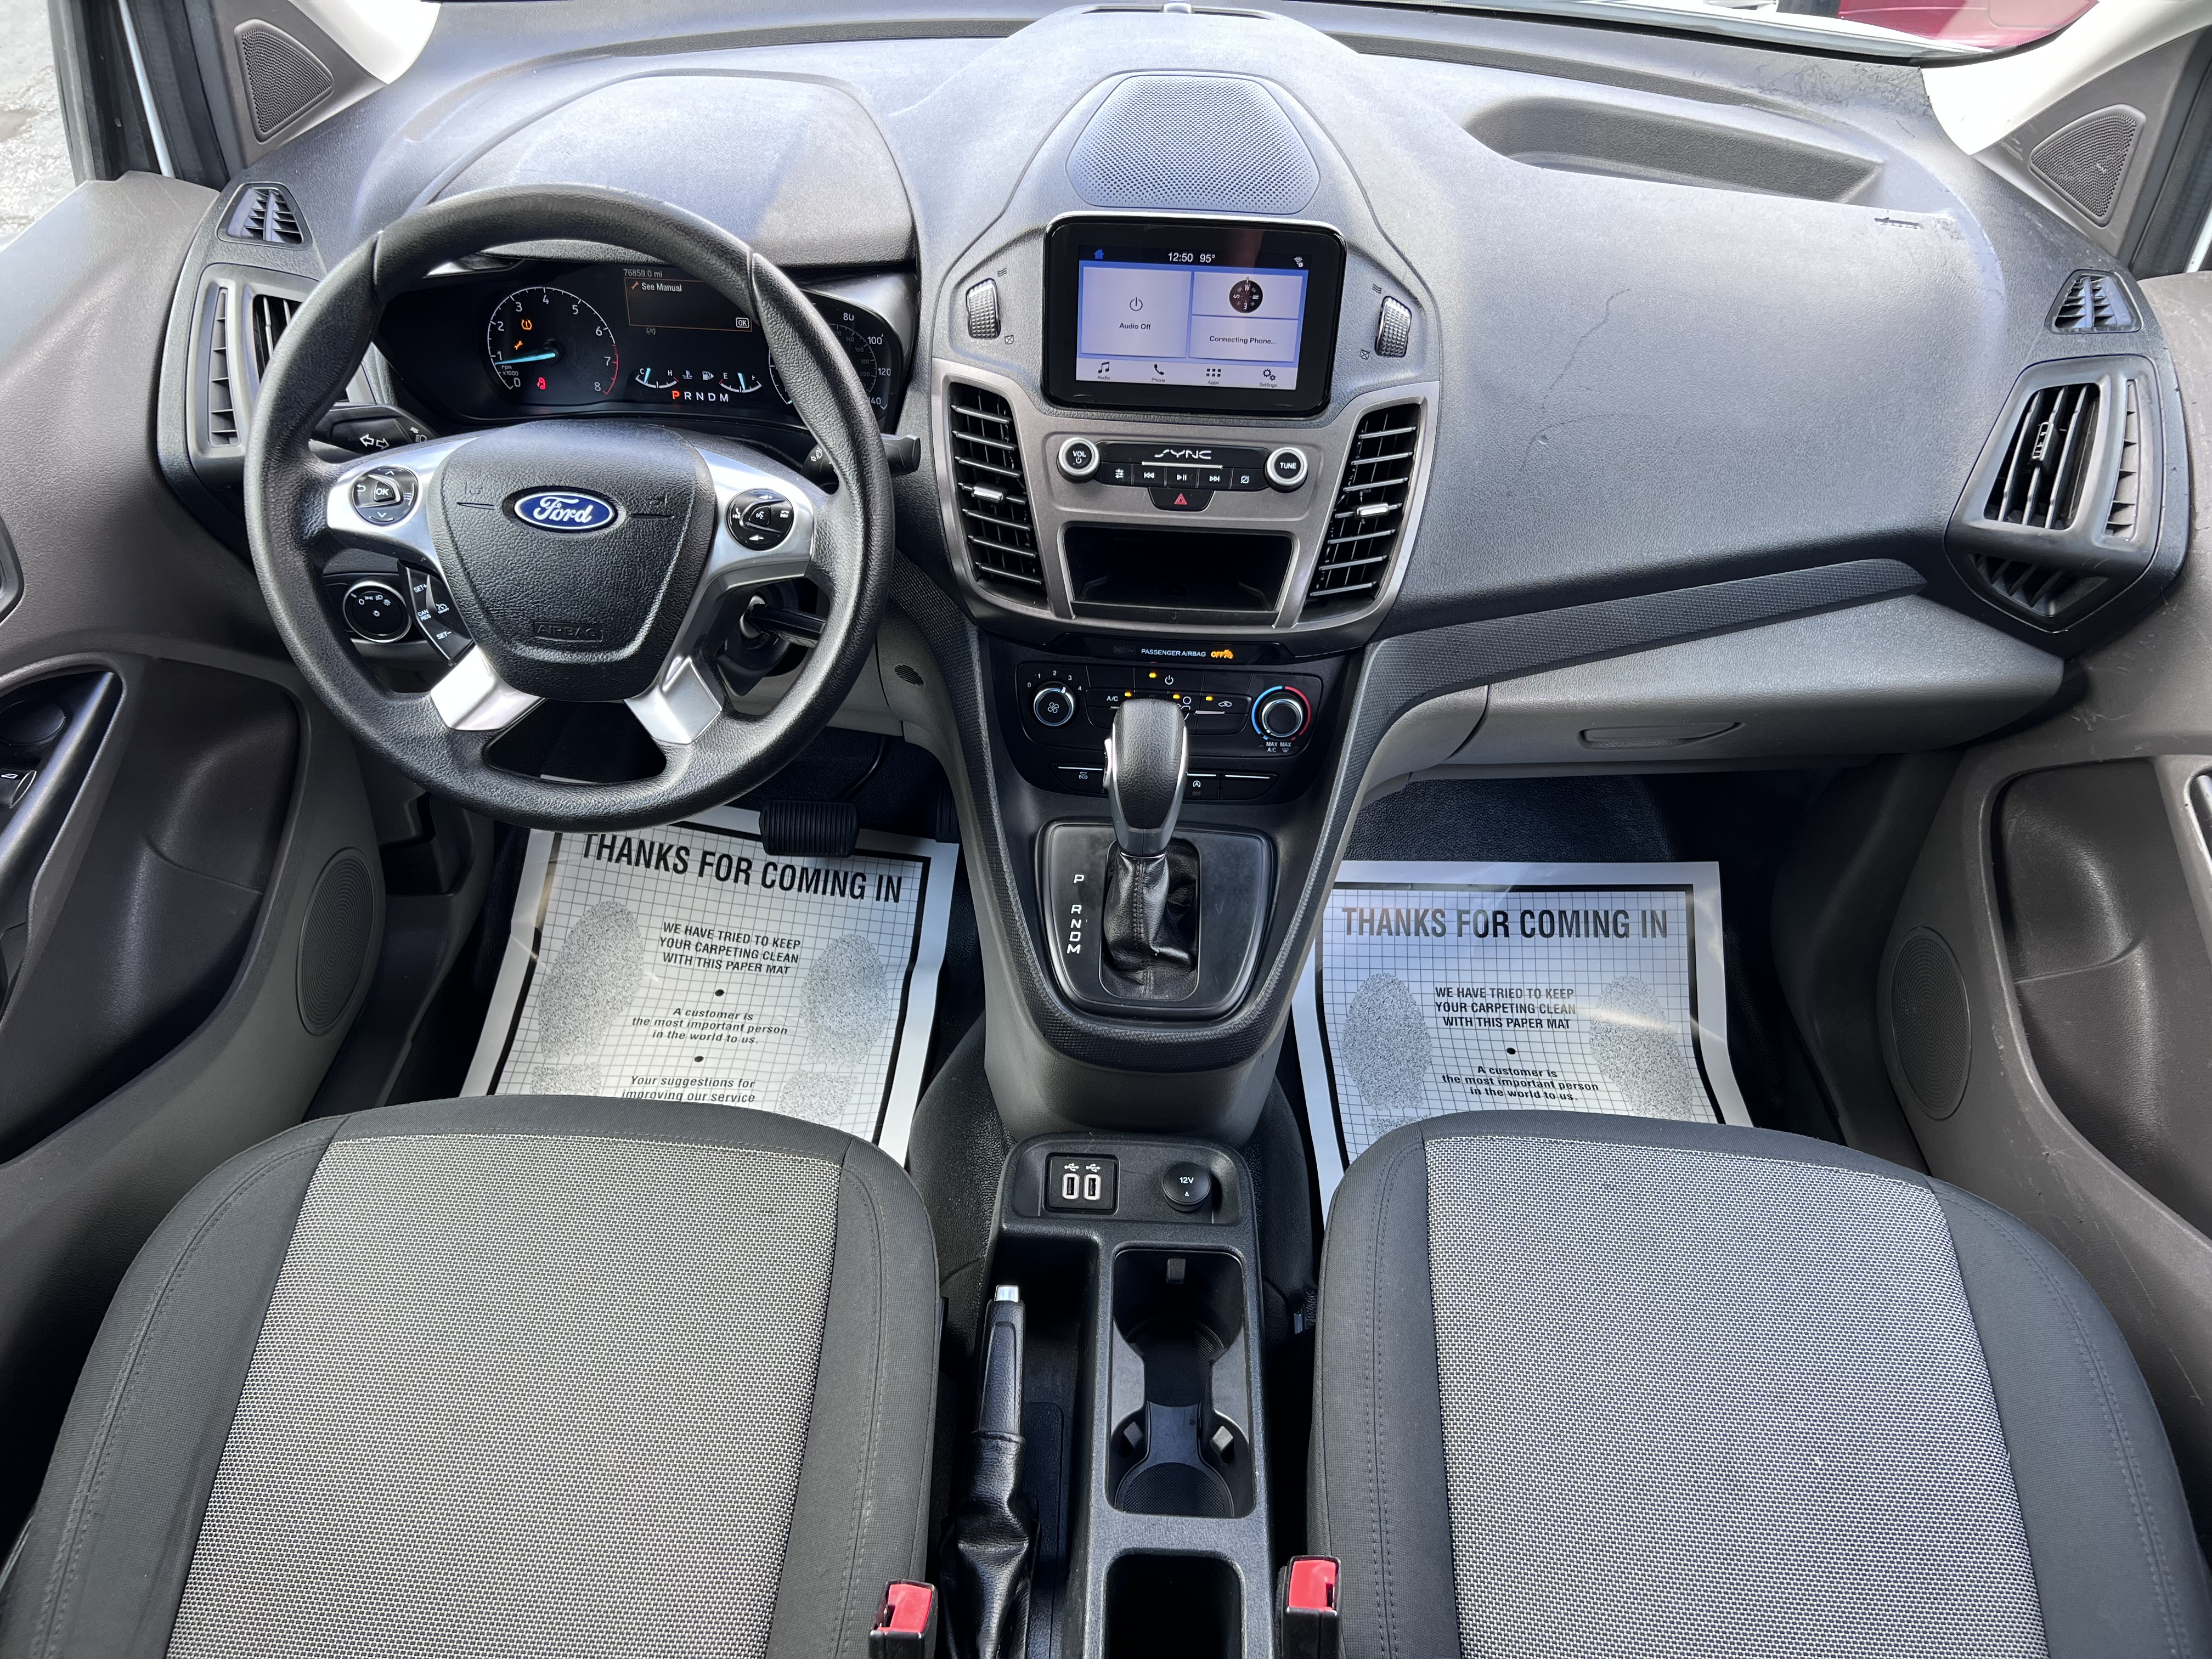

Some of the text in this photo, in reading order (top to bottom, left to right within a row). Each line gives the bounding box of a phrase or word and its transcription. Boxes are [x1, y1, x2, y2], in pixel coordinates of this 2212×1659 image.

[1168, 252, 1216, 263] 12:50 95°
[641, 282, 682, 292] See Manual
[543, 295, 549, 304] 4
[515, 302, 522, 312] 3
[572, 304, 579, 315] 5
[497, 321, 504, 331] 2
[738, 317, 748, 326] OK
[595, 326, 602, 336] 6
[867, 336, 882, 345] 100
[1209, 336, 1248, 344] Connecting
[497, 351, 502, 360] 1
[604, 356, 611, 366] 7
[878, 368, 891, 376] 120
[514, 377, 521, 387] 0
[594, 381, 601, 392] 8
[672, 390, 729, 402] P R N D M
[1154, 449, 1212, 460] SYNC
[375, 487, 390, 496] OK
[534, 495, 593, 524] Ford
[413, 584, 427, 593] SET+
[537, 625, 597, 637] AIRBAG
[1141, 648, 1180, 657] PASSENGER
[1210, 650, 1224, 658] OFF
[584, 834, 902, 902] THANKS FOR COMING IN
[1066, 874, 1085, 954] P R N D M
[1342, 907, 1668, 939] THANKS FOR COMING IN
[664, 922, 800, 950] WE HAVE TRIED TO KEEP
[661, 937, 799, 963] YOUR CARPETING CLEAN
[663, 952, 791, 974] WITH THIS PAPER MAT
[1435, 987, 1574, 999] WE HAVE TRIED TO KEEP
[1436, 1002, 1576, 1014] YOUR CARPETING CLEAN
[685, 1010, 740, 1019] customer
[687, 1020, 744, 1031] important
[747, 1026, 787, 1034] person
[1443, 1017, 1570, 1029] WITH THIS PAPER MAT
[653, 1030, 663, 1038] in
[667, 1031, 685, 1039] the
[690, 1033, 723, 1041] world
[726, 1035, 737, 1043] to
[1489, 1068, 1543, 1077] customer
[1547, 1069, 1558, 1077] is
[631, 1076, 755, 1088] Your suggestions for
[1498, 1077, 1555, 1088] important
[1558, 1082, 1599, 1091] person
[622, 1090, 755, 1102] improving our service
[1470, 1087, 1481, 1095] in
[1485, 1088, 1503, 1096] the
[1507, 1090, 1541, 1098] world
[1544, 1091, 1556, 1099] to
